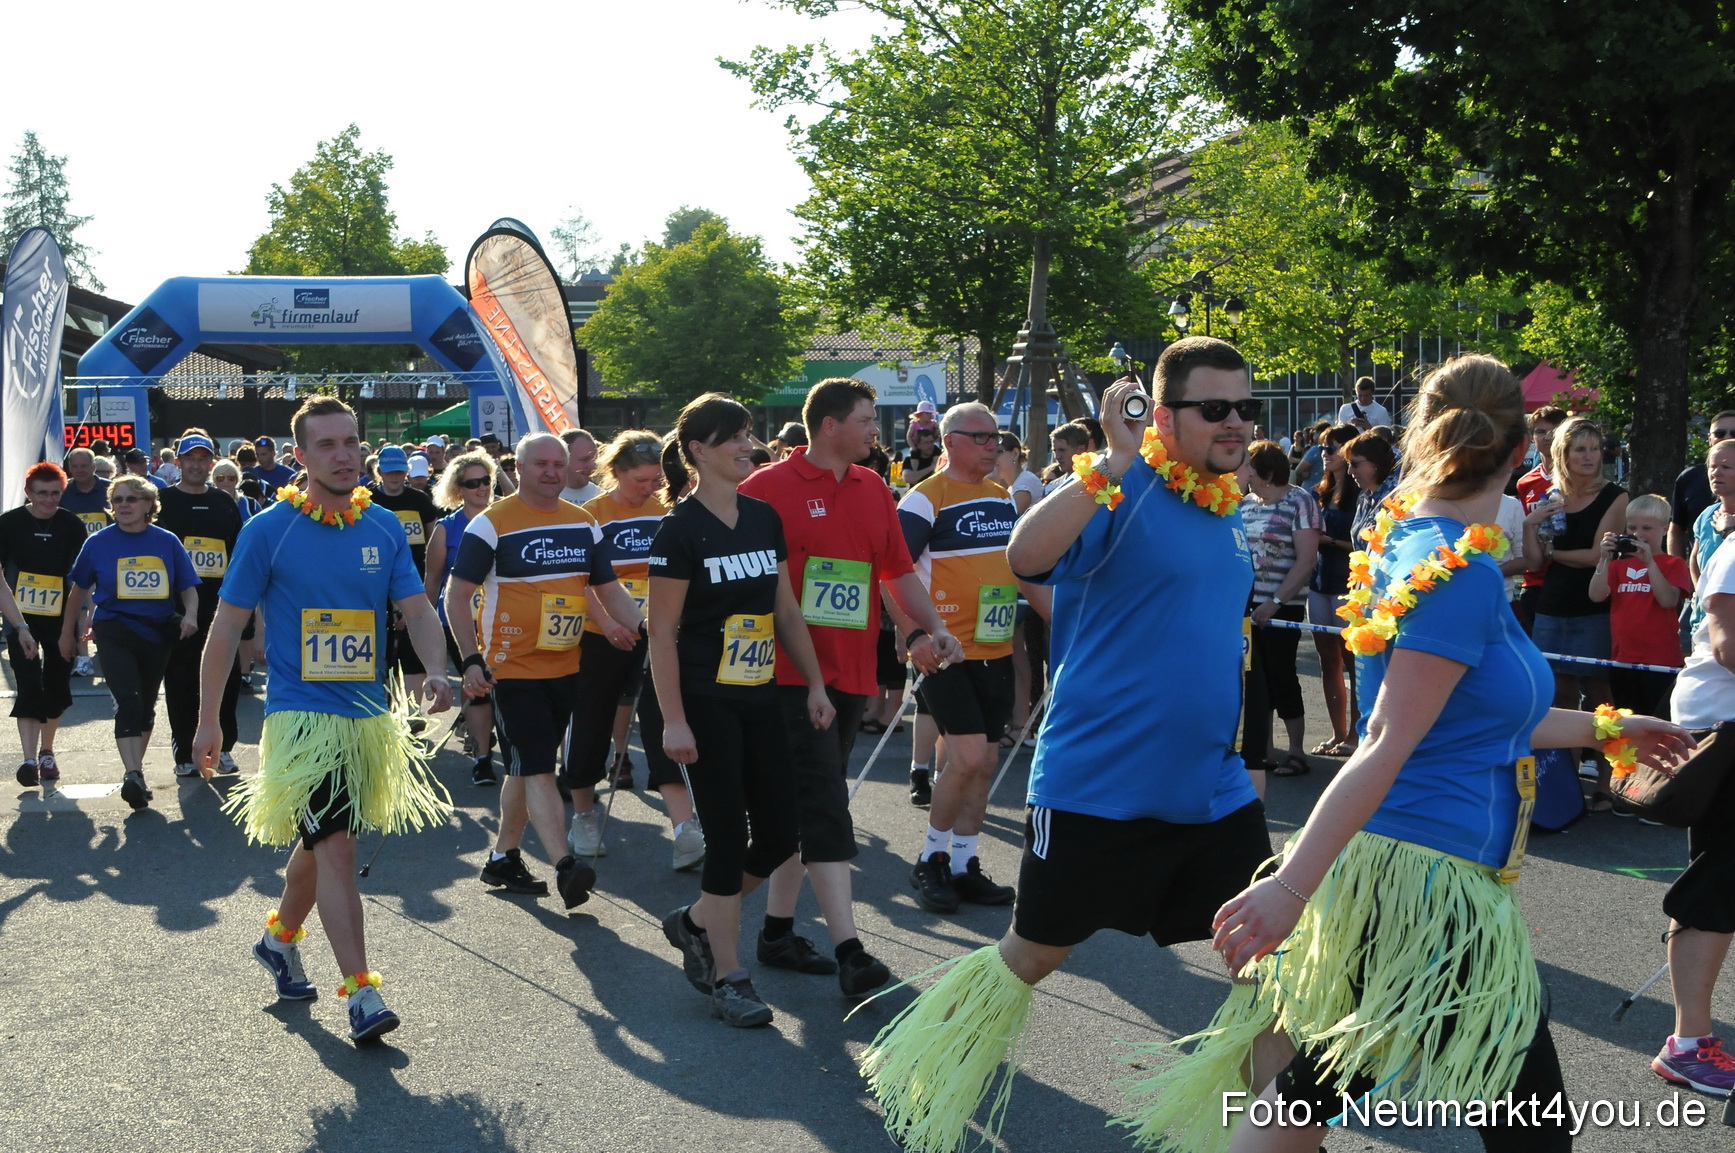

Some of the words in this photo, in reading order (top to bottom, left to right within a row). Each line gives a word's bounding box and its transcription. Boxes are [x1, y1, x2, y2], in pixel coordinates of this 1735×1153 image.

[22, 255, 54, 378] Fischer
[282, 309, 360, 324] firmenlauf
[128, 334, 173, 344] Fischer
[534, 546, 587, 560] Fischer
[541, 557, 586, 566] AUTOMOBILE
[703, 549, 779, 584] THULE
[124, 571, 161, 588] 629
[18, 586, 62, 606] 1117
[813, 581, 861, 612] 768
[547, 614, 583, 637] 370
[983, 604, 1015, 629] 409
[305, 634, 374, 663] 1164
[726, 638, 775, 668] 1402
